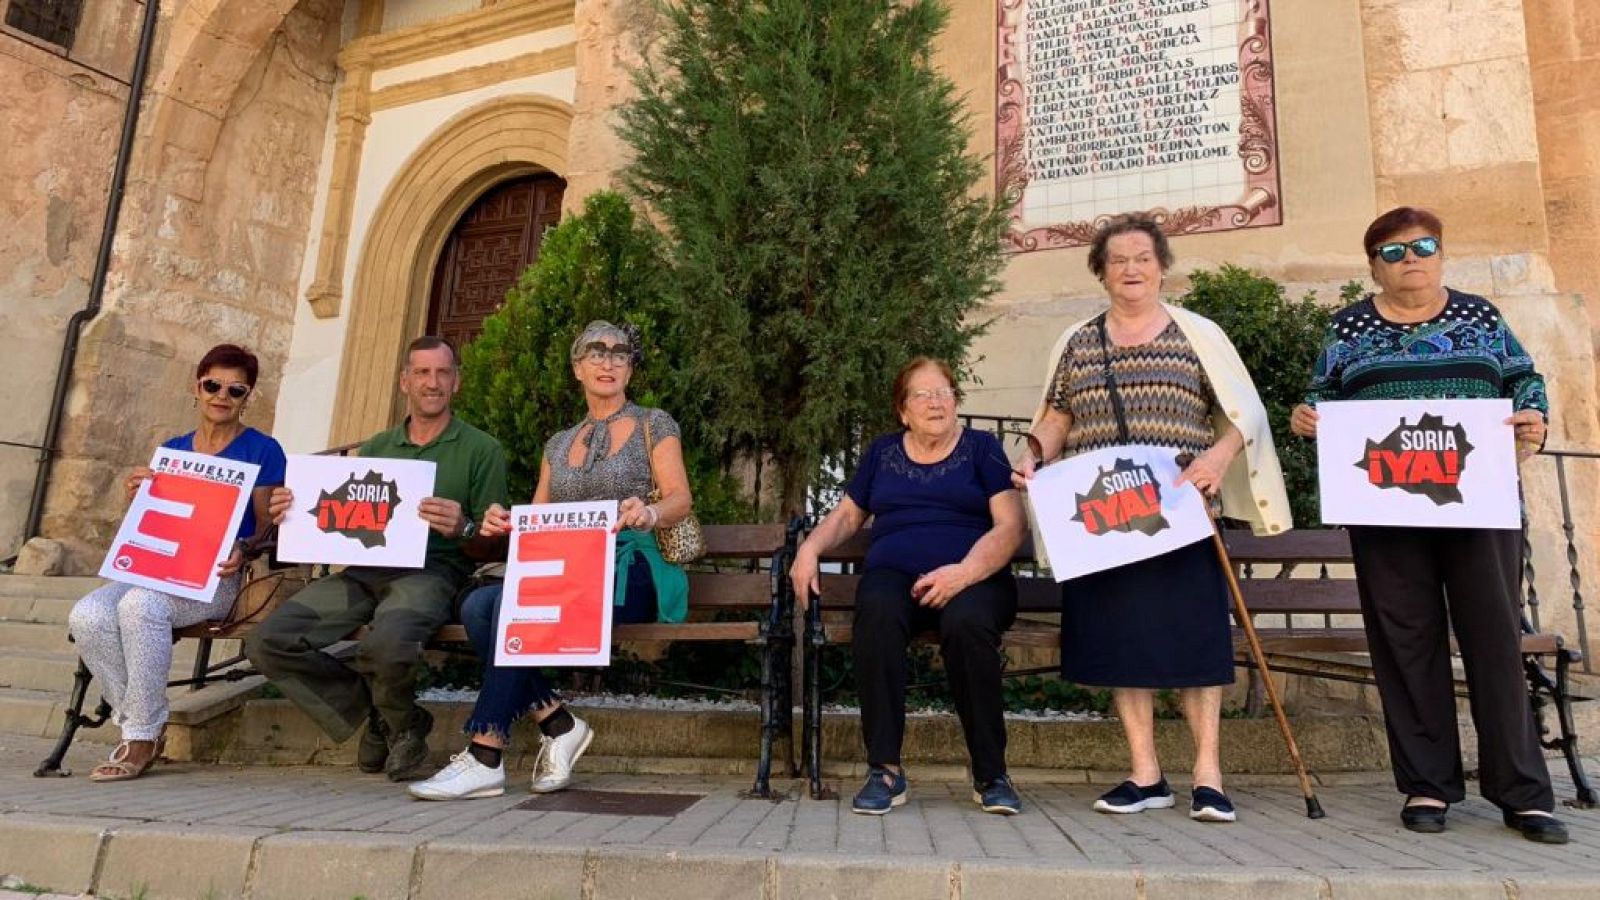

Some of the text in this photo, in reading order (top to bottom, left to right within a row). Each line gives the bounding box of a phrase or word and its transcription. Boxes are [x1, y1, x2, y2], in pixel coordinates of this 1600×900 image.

[1118, 17, 1162, 34] MONGE
[1135, 23, 1196, 43] AGVILAR
[1080, 44, 1138, 64] AGVILAR
[1144, 33, 1200, 52] BODEGA
[1120, 49, 1166, 67] MONGE
[1135, 62, 1237, 87] BALLESTEROS
[1185, 73, 1239, 91] MOLINO
[1143, 88, 1219, 108] MARTINEZ
[1143, 101, 1208, 119] CEBOLLA
[1173, 121, 1230, 138] MONTON
[1026, 144, 1231, 183] MARIANO COLADO BARTOLOME
[1027, 136, 1203, 171] ANTONIO AGREDA MEDINA
[1400, 430, 1457, 450] SORIA
[159, 457, 245, 481] REVUELTA
[1369, 450, 1458, 484] ¡YA!
[1102, 467, 1150, 495] SORIA
[348, 483, 390, 502] SORIA
[318, 499, 389, 531] ¡YA!
[518, 511, 608, 525] REVUELTA
[1080, 482, 1161, 534] ¡YA!
